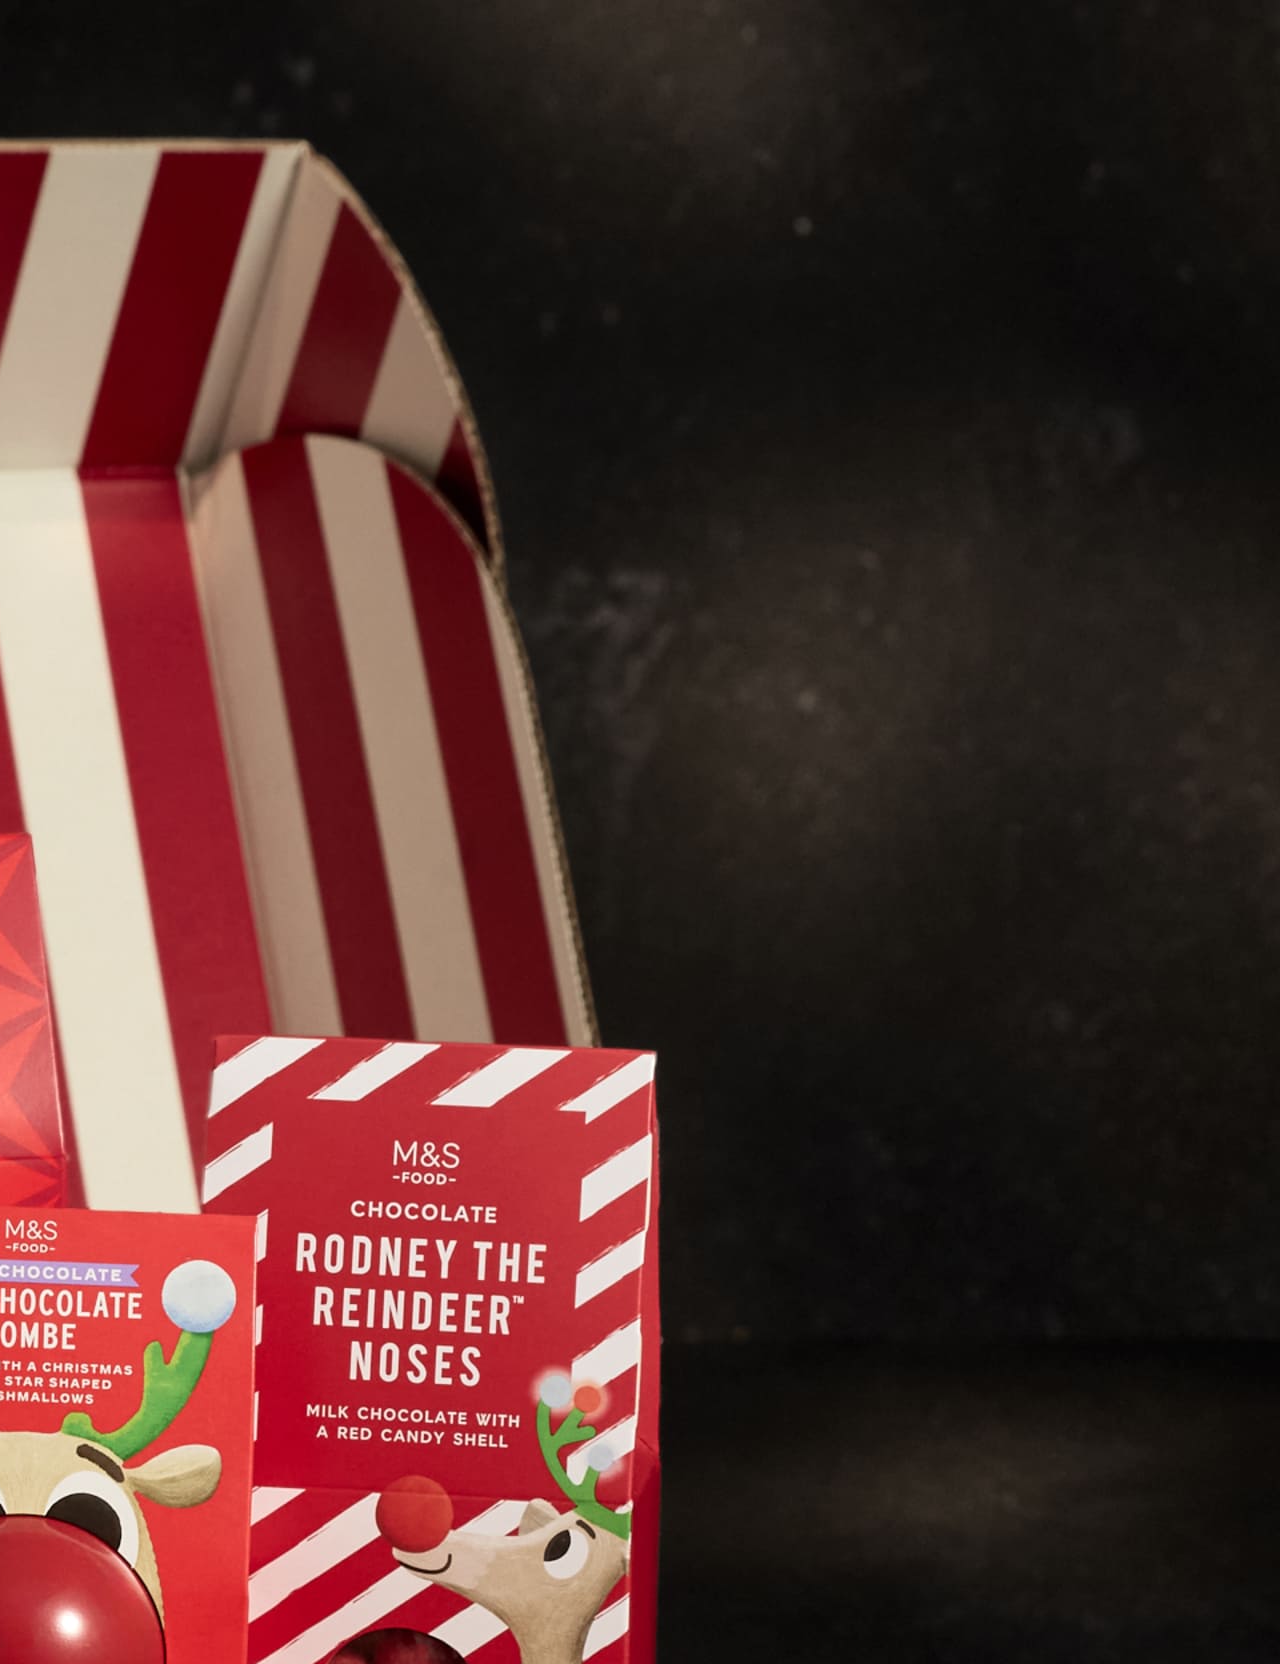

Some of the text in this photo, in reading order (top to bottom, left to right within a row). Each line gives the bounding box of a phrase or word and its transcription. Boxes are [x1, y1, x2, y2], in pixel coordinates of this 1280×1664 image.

[394, 1141, 459, 1168] M&S
[351, 1201, 496, 1223] CHOCOLATE
[6, 1219, 57, 1240] M&S
[296, 1233, 546, 1283] RODNEY THE
[27, 1362, 36, 1371] A
[43, 1362, 132, 1375] CHRISTMAS
[350, 1341, 480, 1386] NOSES
[5, 1376, 43, 1386] STAR
[49, 1378, 111, 1389] SHAPED
[307, 1405, 519, 1427] MILK CHOCOLATE WITH
[317, 1426, 507, 1447] A RED CANDY SHELL
